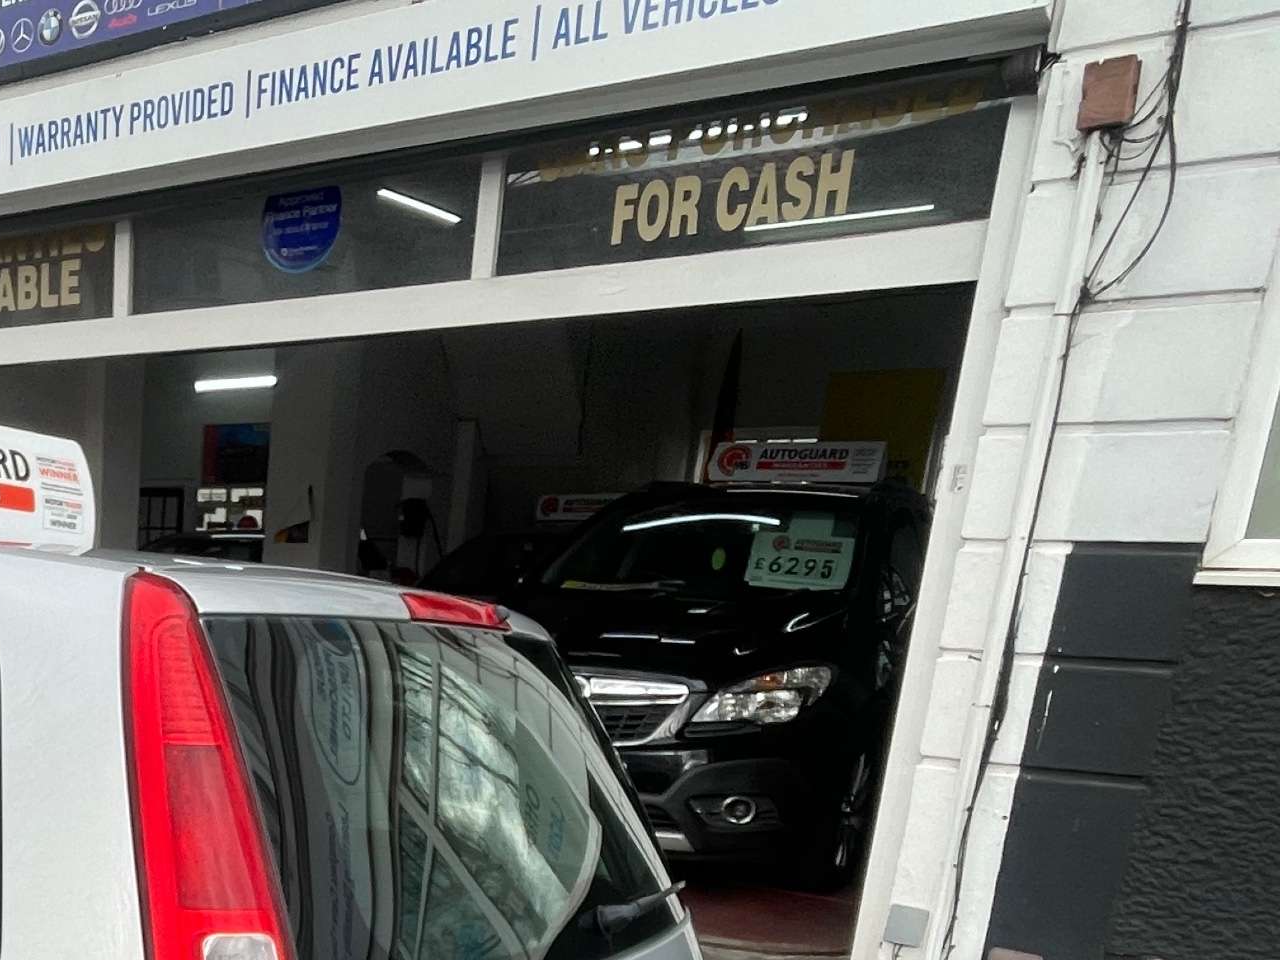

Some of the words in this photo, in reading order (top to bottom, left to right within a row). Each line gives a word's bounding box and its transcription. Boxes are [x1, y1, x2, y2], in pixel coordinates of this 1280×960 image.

[18, 104, 124, 158] WARRANTY
[129, 81, 234, 136] PROVIDED
[256, 51, 362, 110] FINANCE
[367, 17, 519, 87] AVAILABLE
[551, 0, 609, 50] ALL
[610, 174, 702, 246] FOR
[716, 148, 856, 233] CASH
[760, 448, 850, 461] AUTOGUARD
